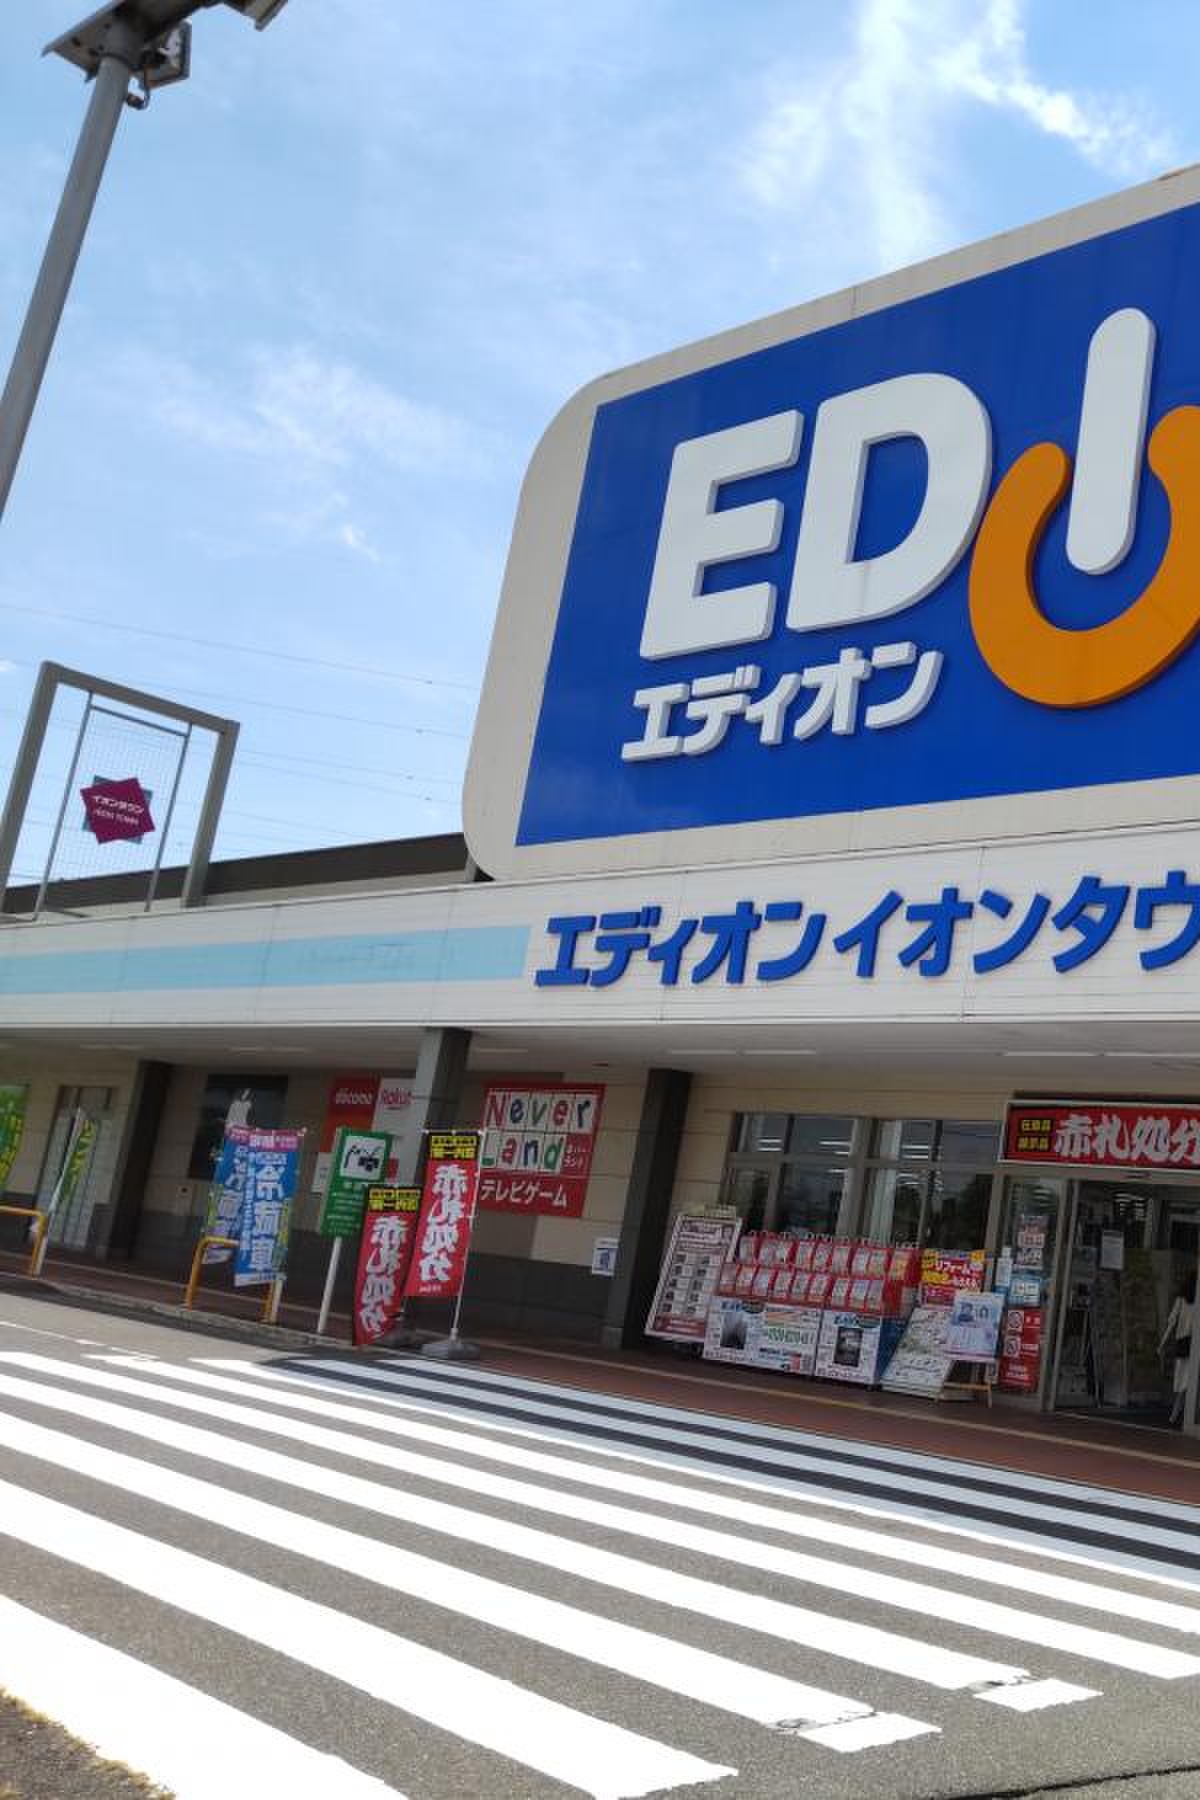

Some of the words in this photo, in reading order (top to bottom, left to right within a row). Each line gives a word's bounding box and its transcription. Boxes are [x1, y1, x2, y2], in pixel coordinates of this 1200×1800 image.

[620, 640, 944, 761] エディオン
[487, 1094, 591, 1128] Never
[480, 1178, 568, 1208] テレビゲーム
